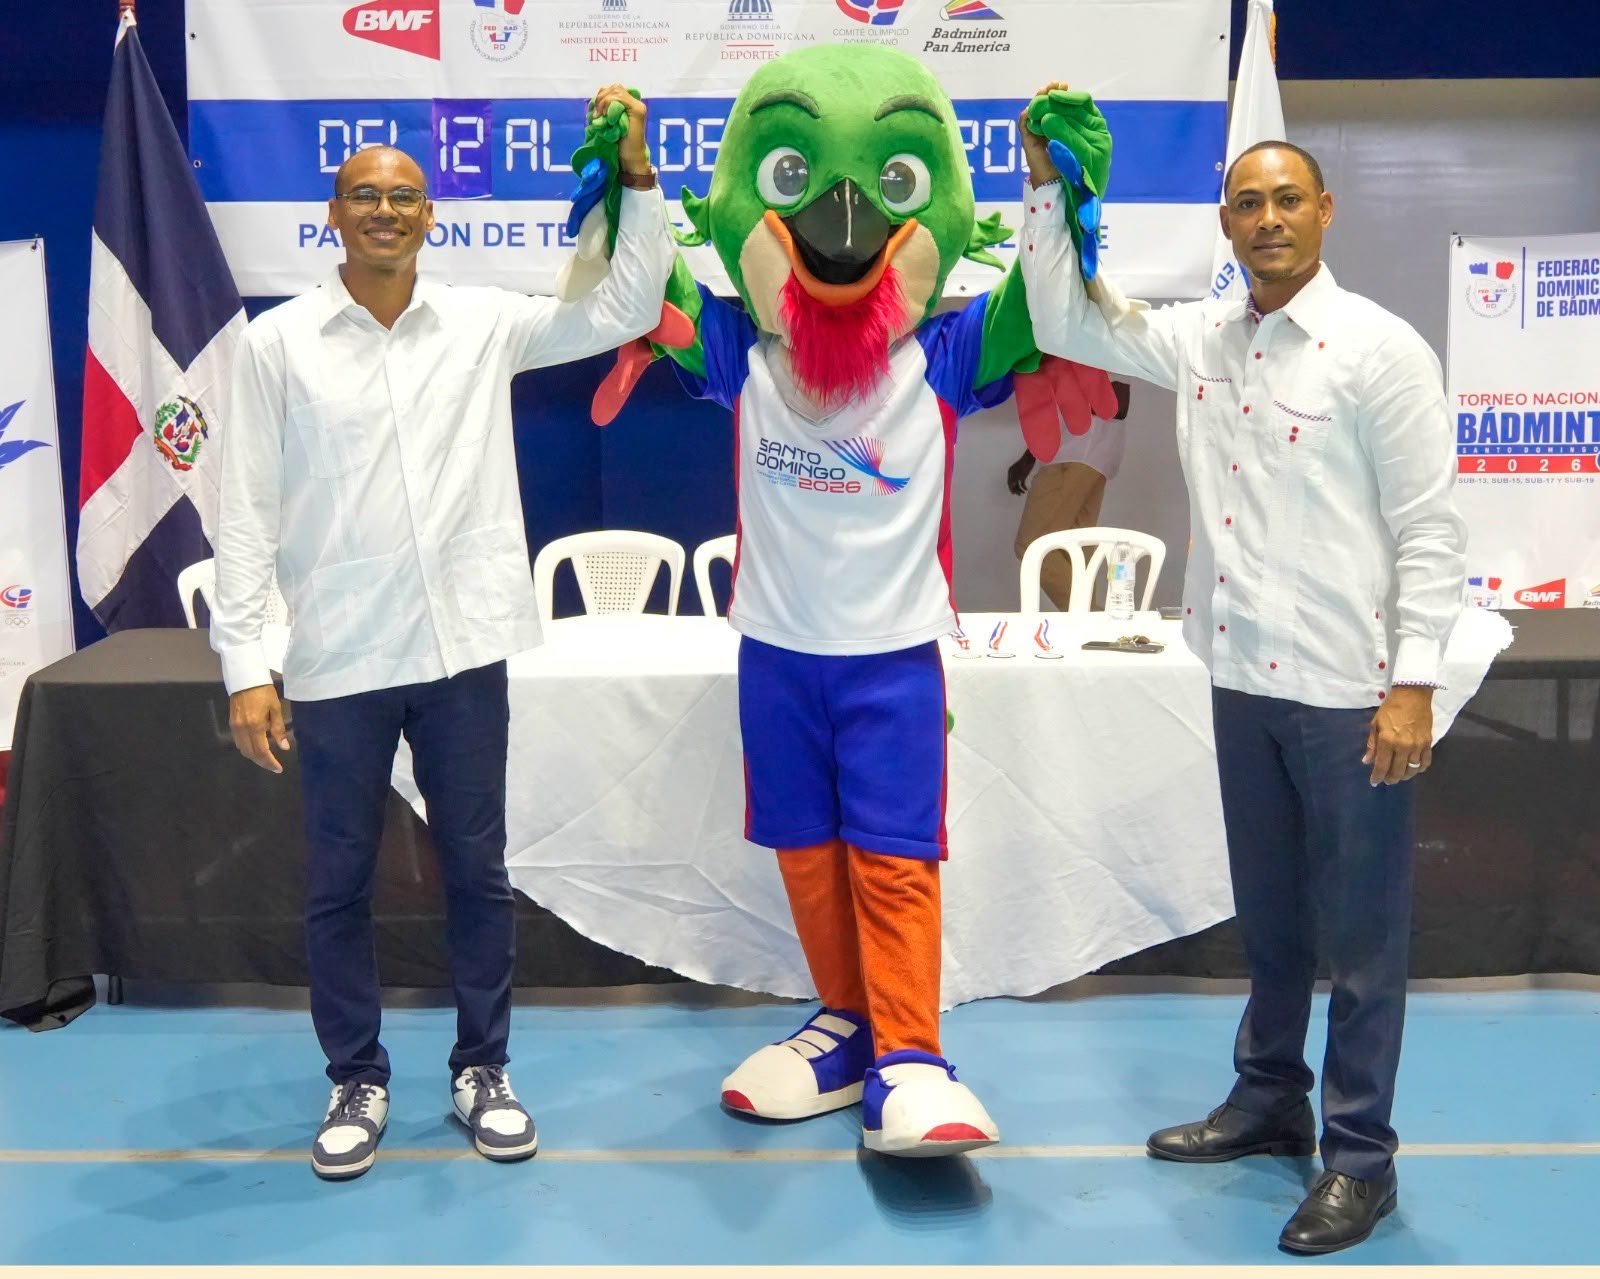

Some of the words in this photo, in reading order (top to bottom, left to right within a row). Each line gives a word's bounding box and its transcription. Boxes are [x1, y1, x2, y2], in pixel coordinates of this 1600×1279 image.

[355, 10, 433, 31] BWF
[747, 32, 816, 41] DOMINICANA
[932, 27, 1008, 39] Badminton
[922, 41, 950, 53] Pan
[951, 41, 1011, 53] America
[588, 48, 639, 62] INEFI
[720, 50, 780, 60] DEPORTES
[439, 115, 485, 173] 12
[505, 118, 574, 172] AL
[659, 117, 726, 172] DE
[483, 221, 527, 248] DE
[1536, 300, 1554, 317] DE
[1458, 394, 1527, 406] TORNEO
[1533, 392, 1600, 405] NACION
[759, 438, 822, 465] SANTO
[756, 451, 846, 480] DOMINGO
[1476, 458, 1581, 472] 2026
[798, 477, 862, 494] 2026
[1520, 591, 1562, 602] BWF
